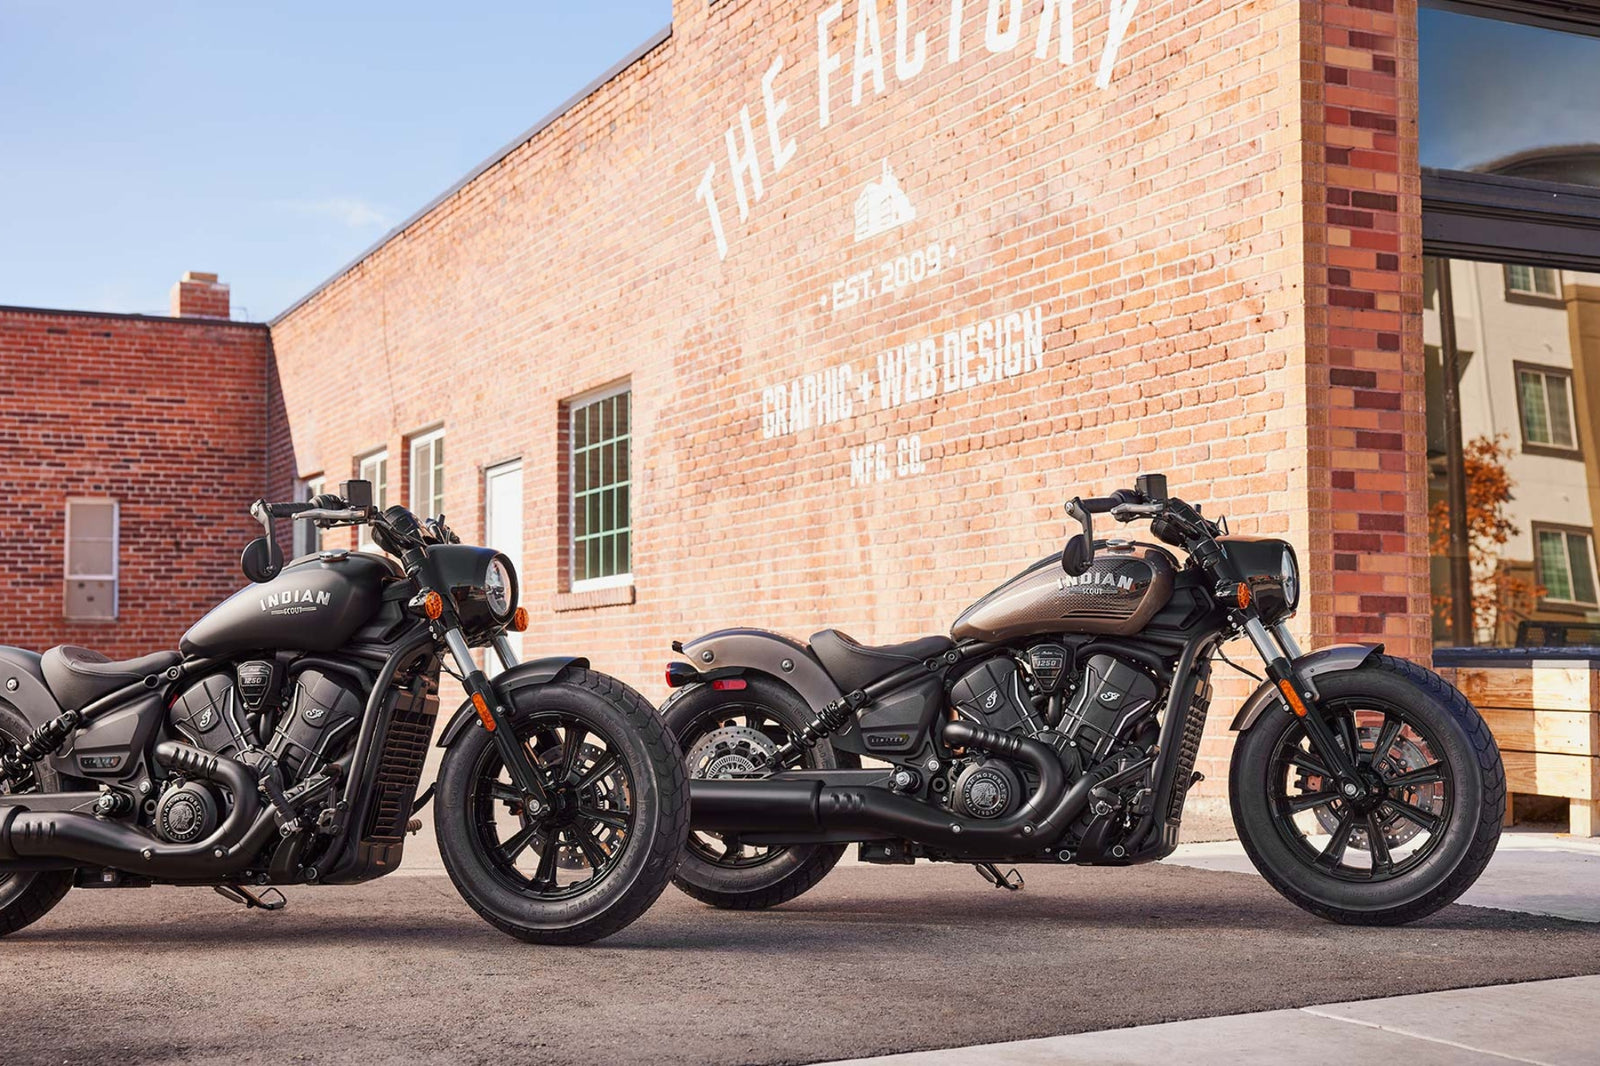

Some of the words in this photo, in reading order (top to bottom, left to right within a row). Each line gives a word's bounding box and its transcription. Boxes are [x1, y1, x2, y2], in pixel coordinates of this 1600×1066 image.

[696, 54, 797, 261] THE
[832, 269, 876, 312] EST.
[880, 242, 941, 293] 2009
[761, 364, 853, 440] GRAPHIC
[877, 339, 938, 409] WEB
[943, 305, 1044, 393] DESIGN
[897, 434, 926, 476] CO.
[1057, 571, 1134, 591] INDIAN
[1083, 587, 1103, 595] SCOUT
[260, 589, 331, 612] INDIAN
[283, 606, 303, 615] SCOUT
[244, 676, 262, 684] 1250
